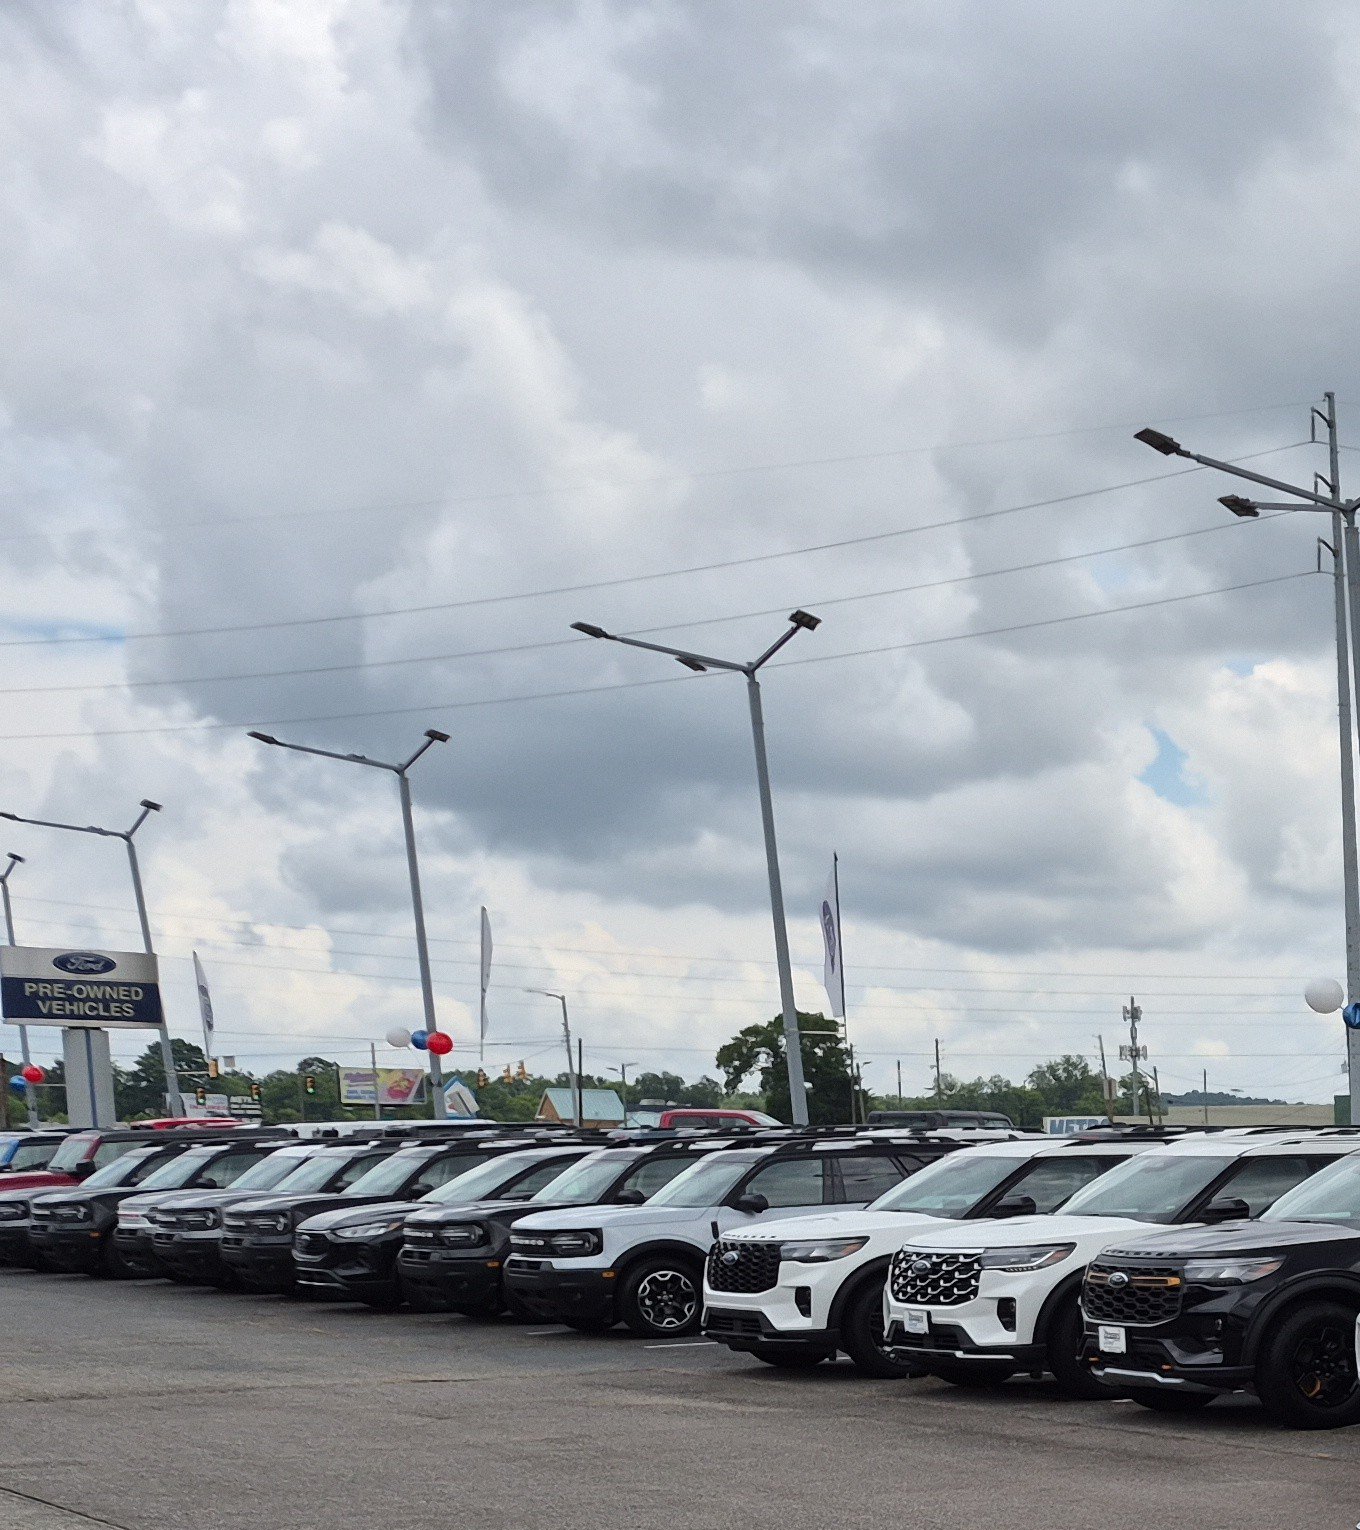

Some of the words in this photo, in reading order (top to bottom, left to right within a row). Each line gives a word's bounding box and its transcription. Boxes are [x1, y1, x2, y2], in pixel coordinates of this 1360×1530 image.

[66, 956, 106, 972] Ford
[24, 982, 144, 1001] PRE-OWNED
[37, 1000, 136, 1017] VEHICLES
